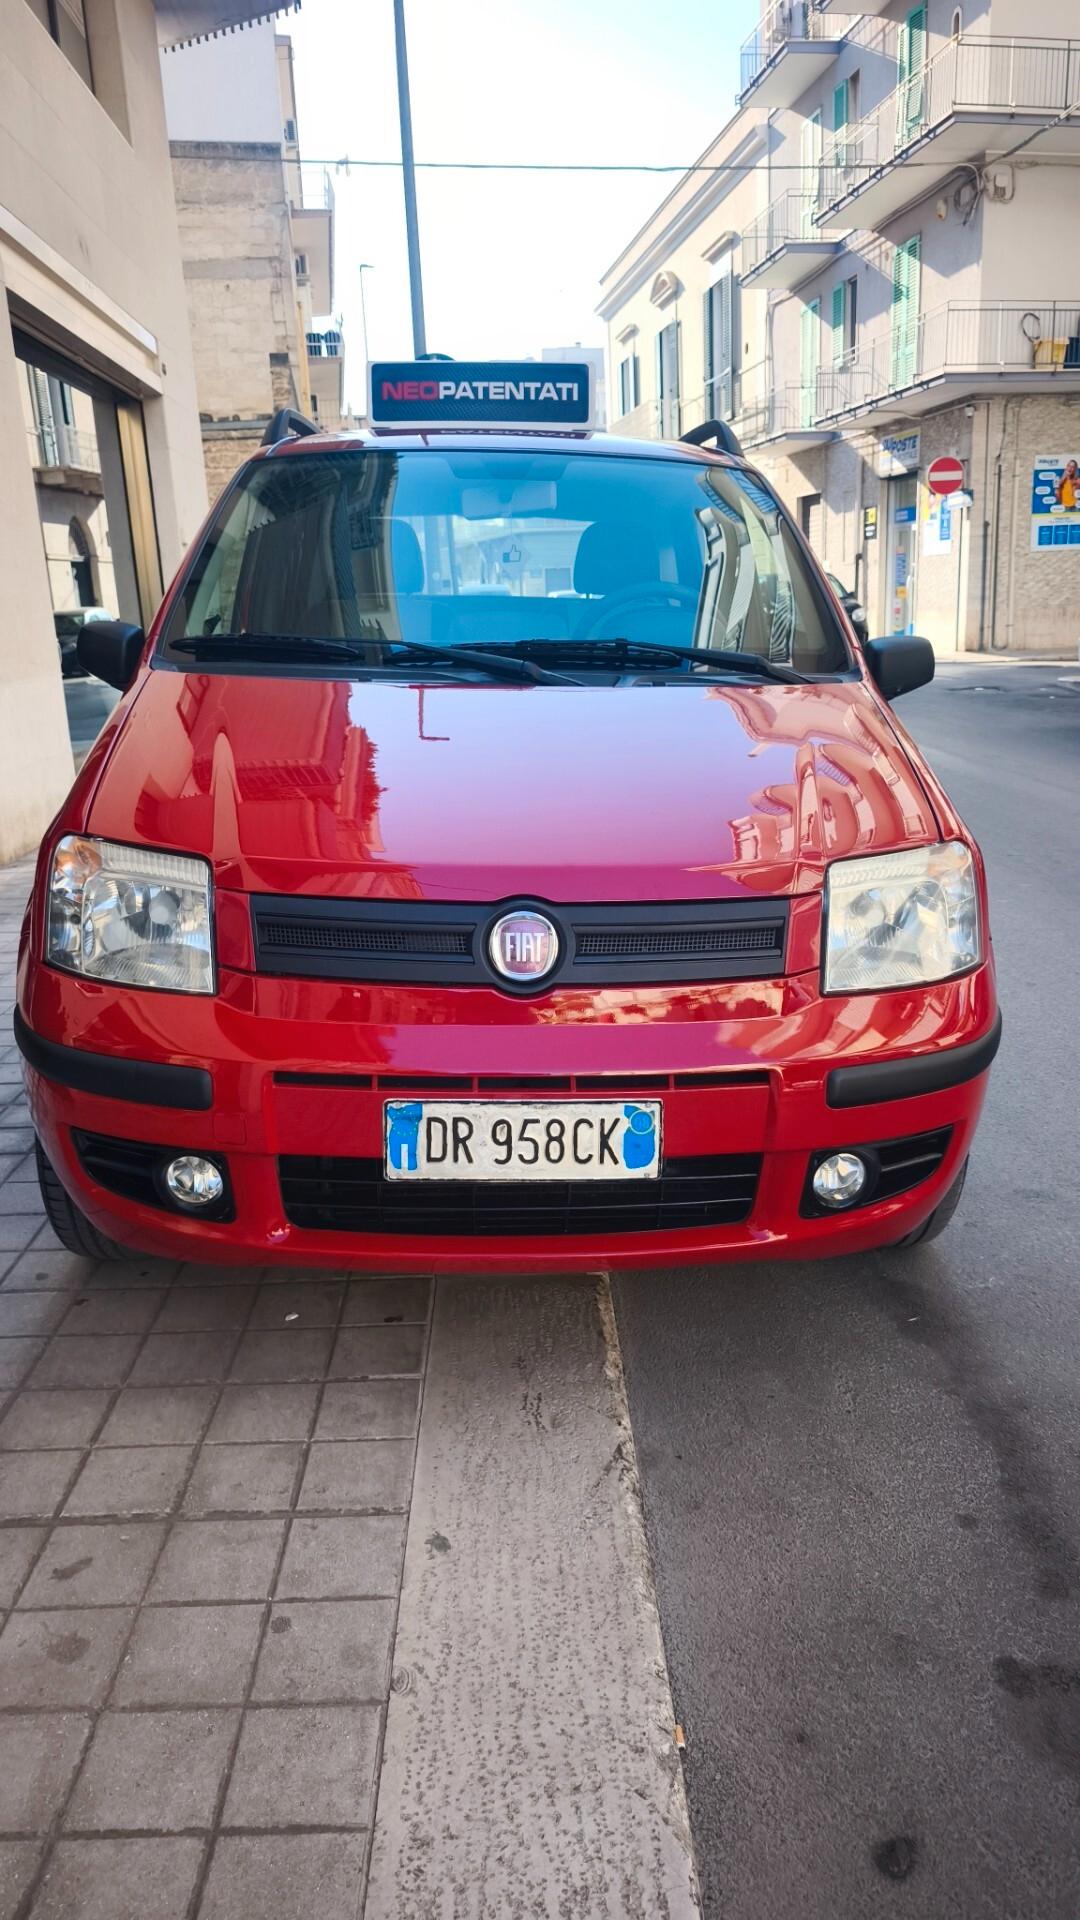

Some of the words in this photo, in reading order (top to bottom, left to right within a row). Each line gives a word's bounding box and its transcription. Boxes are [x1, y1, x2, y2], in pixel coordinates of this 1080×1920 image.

[382, 381, 579, 401] NEOPATENTATI
[504, 932, 545, 962] FIAT
[426, 1116, 474, 1164] DR
[491, 1117, 621, 1165] 958CK
